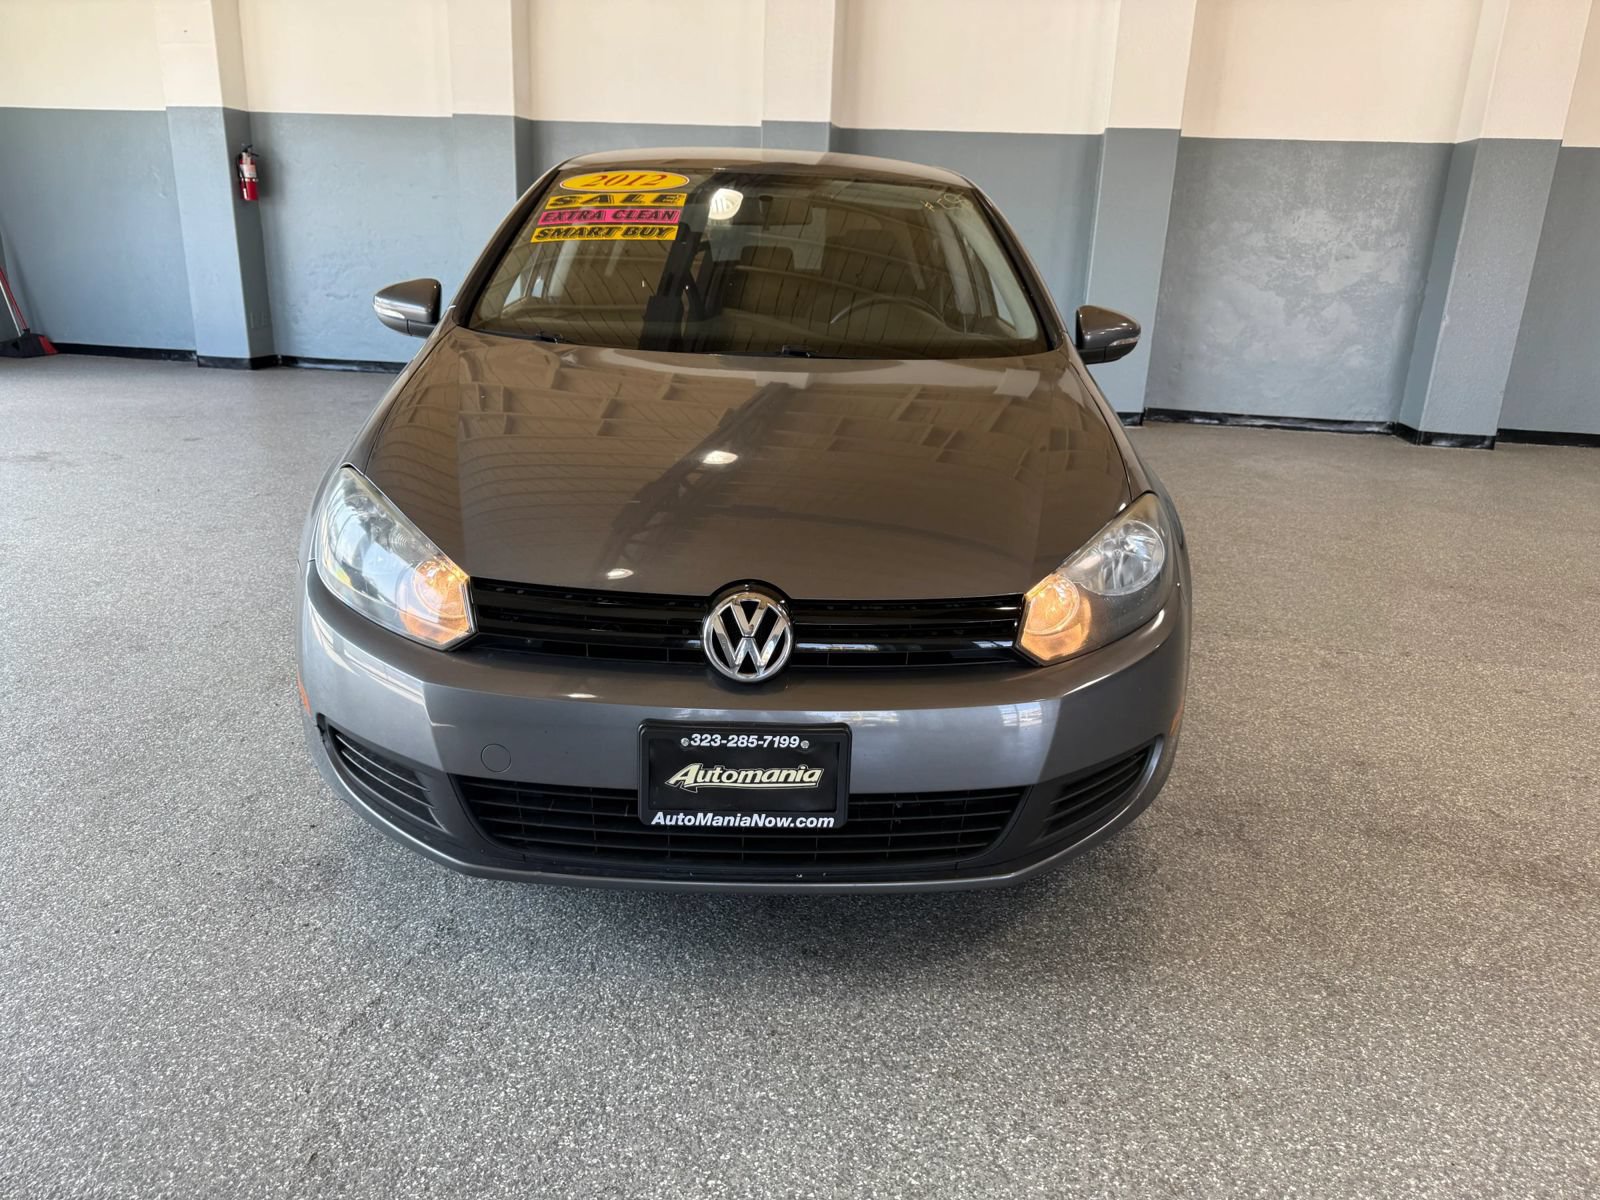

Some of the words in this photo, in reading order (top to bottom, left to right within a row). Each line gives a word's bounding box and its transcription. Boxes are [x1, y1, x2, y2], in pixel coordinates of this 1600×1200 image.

[581, 174, 668, 187] 2012
[549, 194, 683, 206] SALE
[543, 210, 605, 222] EXTRA
[612, 209, 678, 221] CLEAN
[536, 227, 621, 239] SMART
[622, 226, 674, 238] BUY
[705, 594, 790, 680] VW
[690, 733, 800, 749] 323-285-7199
[665, 763, 824, 789] Automania
[651, 811, 835, 828] AutoManiaNow.com
